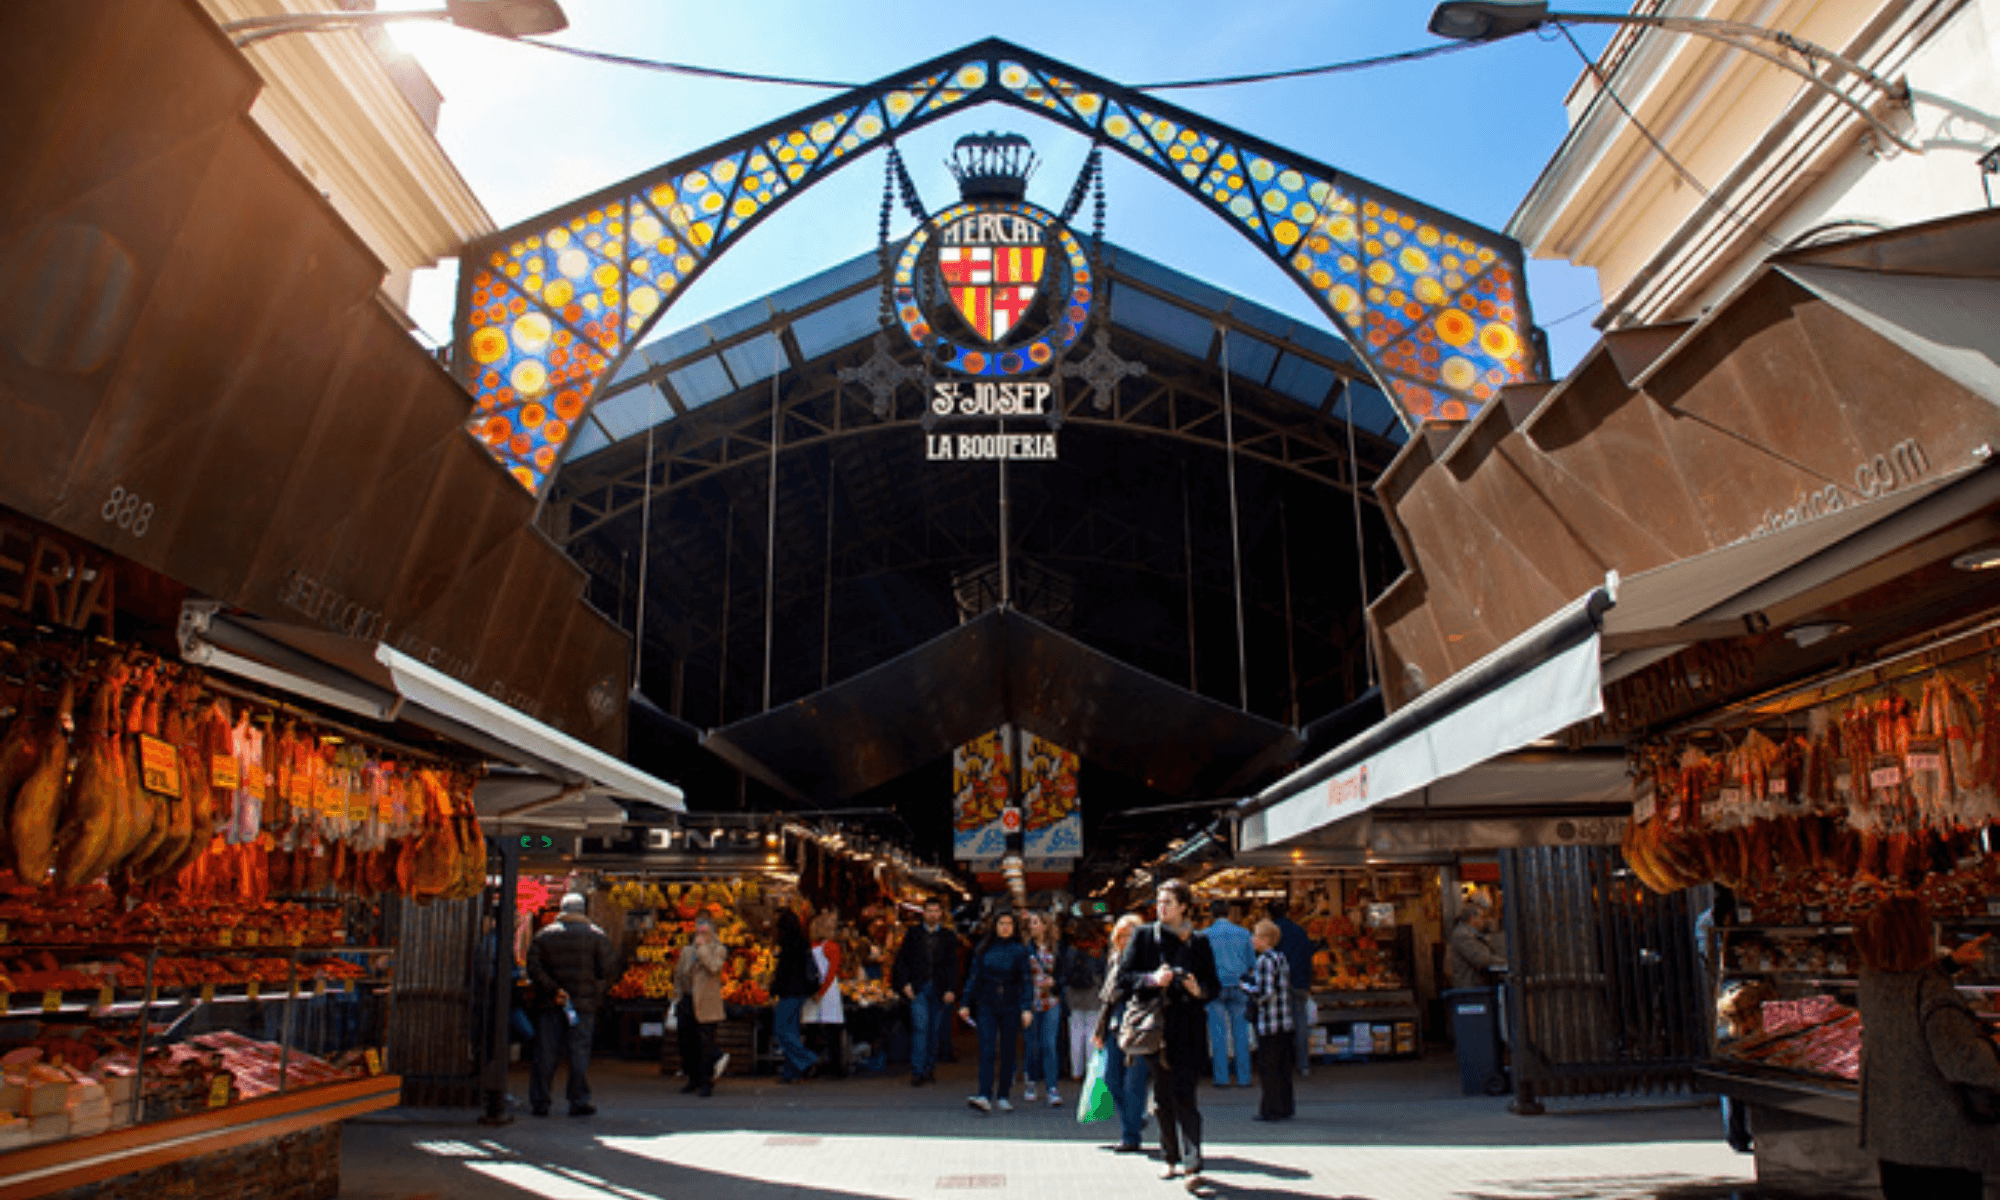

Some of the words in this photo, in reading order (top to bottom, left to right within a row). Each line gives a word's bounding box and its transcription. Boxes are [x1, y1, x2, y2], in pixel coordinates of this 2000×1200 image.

[942, 213, 1043, 244] MERCAT
[960, 382, 1051, 415] JOSEP
[926, 434, 953, 459] LA
[957, 434, 1057, 459] BOQUERIA
[102, 485, 155, 538] 888
